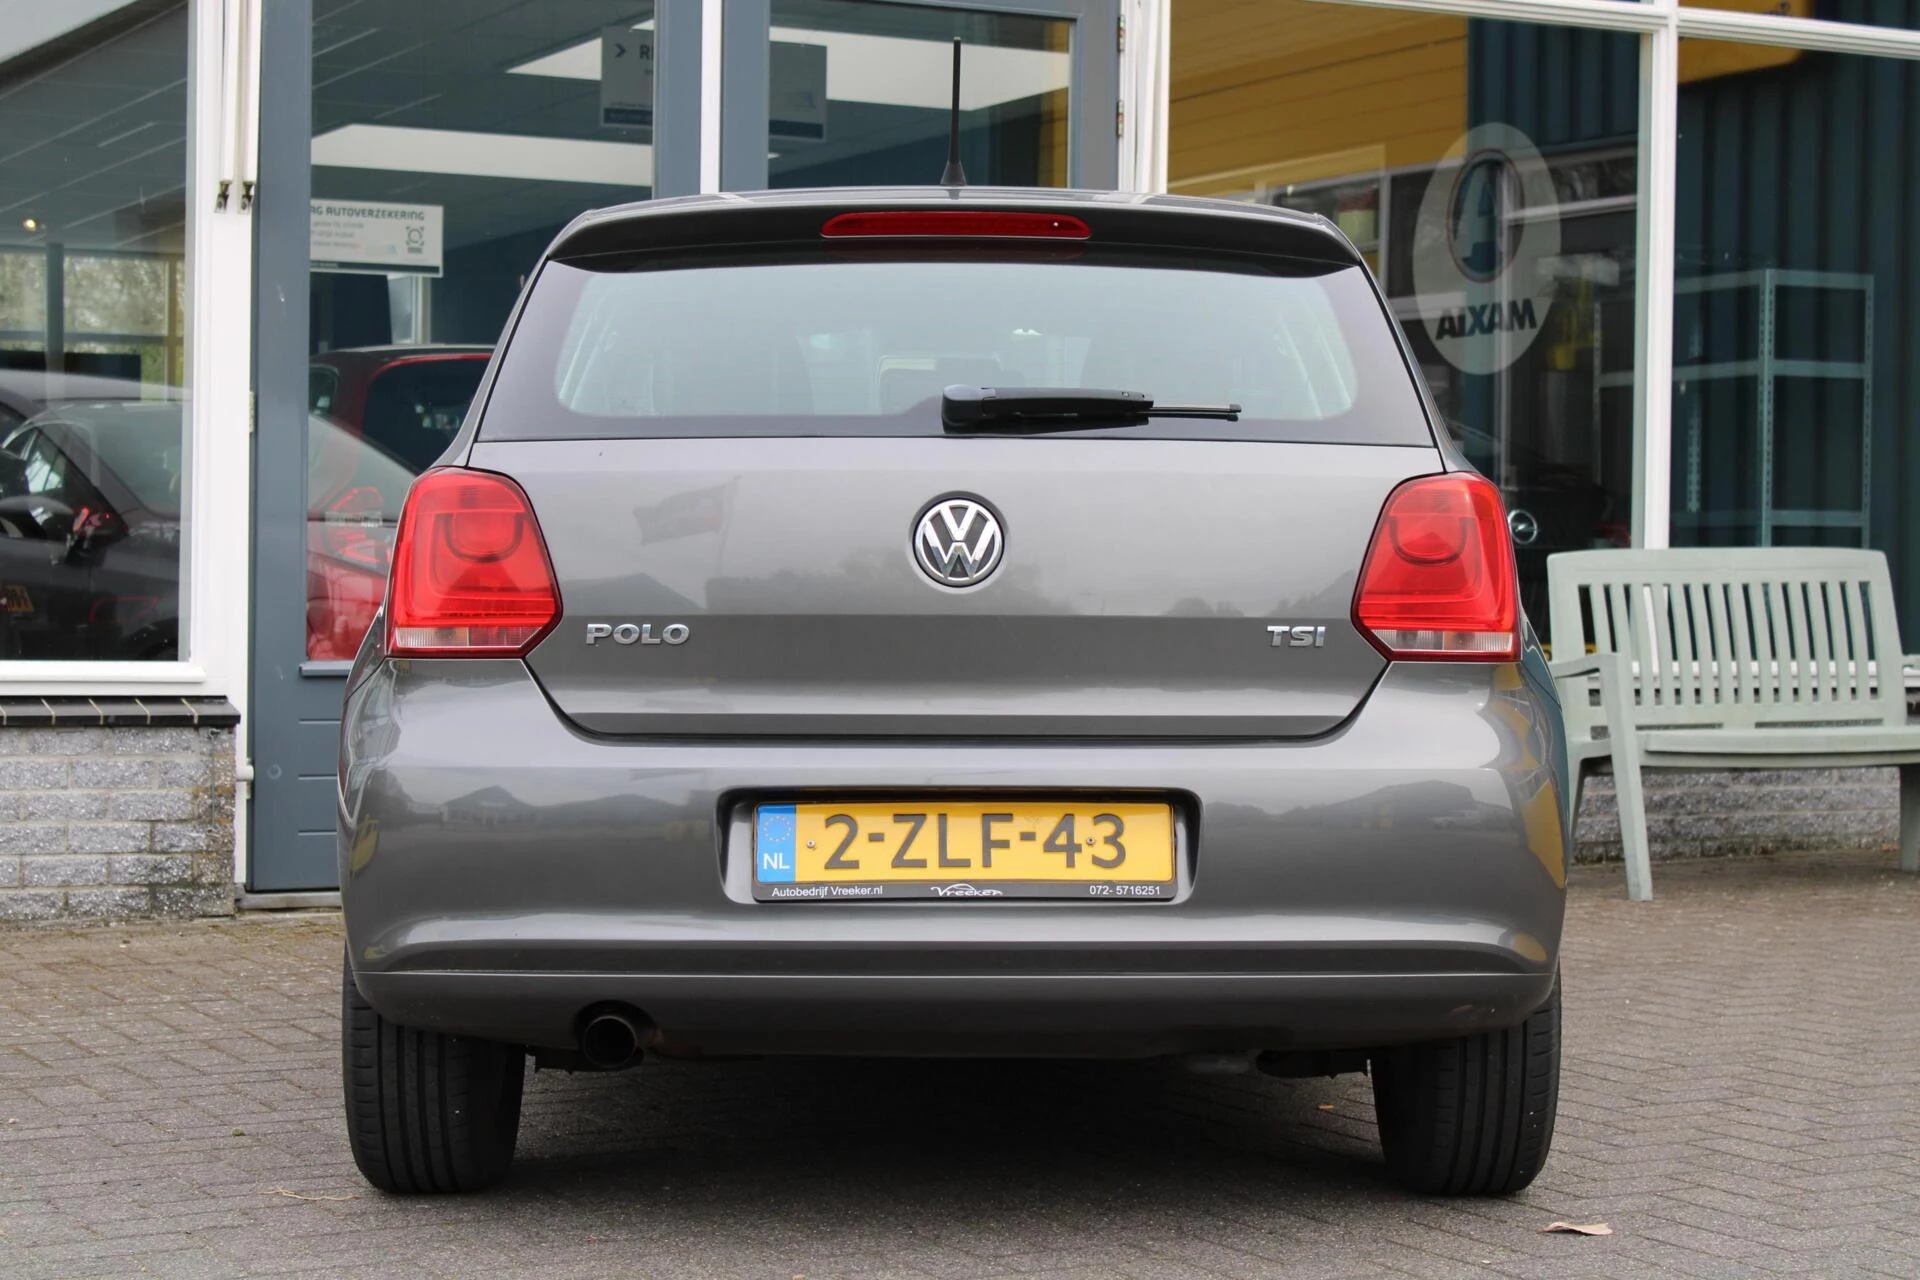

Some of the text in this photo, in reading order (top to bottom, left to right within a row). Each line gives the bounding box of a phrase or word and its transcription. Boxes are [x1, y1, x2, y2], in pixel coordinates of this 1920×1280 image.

[326, 206, 425, 220] AUTOVERZEKERING
[1435, 298, 1537, 341] AIXAM
[585, 623, 690, 645] POLO
[1266, 625, 1326, 647] TSI
[823, 812, 1126, 869] 2-ZLF-43
[762, 853, 790, 869] NL
[772, 885, 883, 897] Autobedrijf Vreeker.nl
